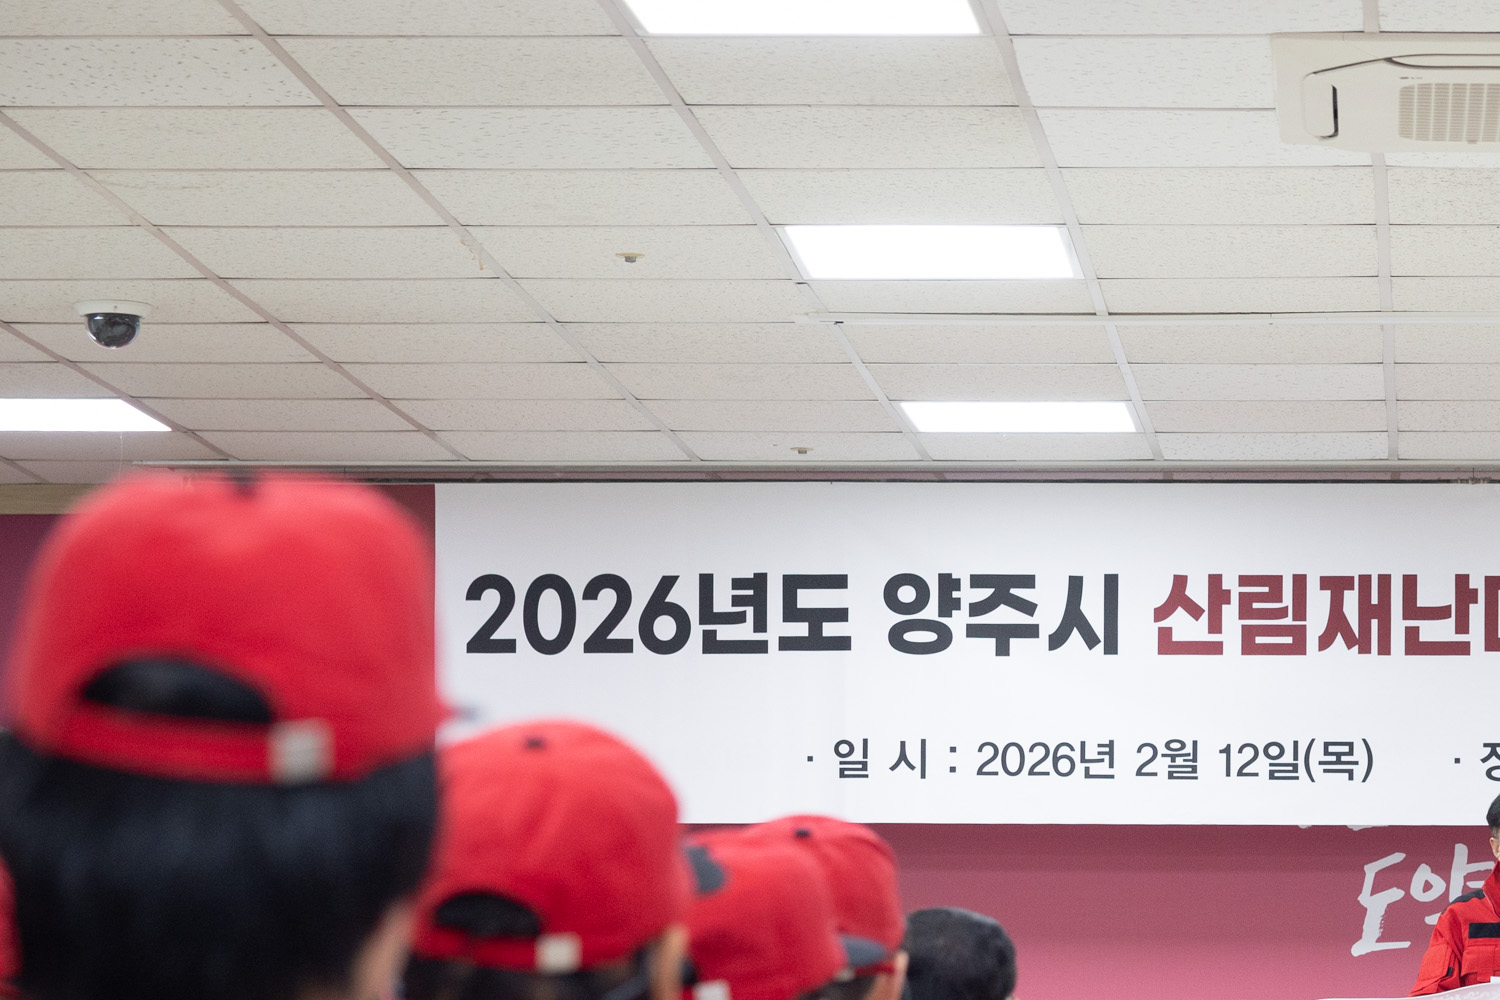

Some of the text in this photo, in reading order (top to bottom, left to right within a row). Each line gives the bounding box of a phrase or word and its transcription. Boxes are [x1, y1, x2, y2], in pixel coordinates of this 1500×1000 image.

[466, 573, 851, 656] 2026년도
[883, 573, 1119, 657] 양주시
[976, 739, 1115, 780] 2026년
[1135, 739, 1199, 780] 2월
[1218, 738, 1374, 783] 12일(목)
